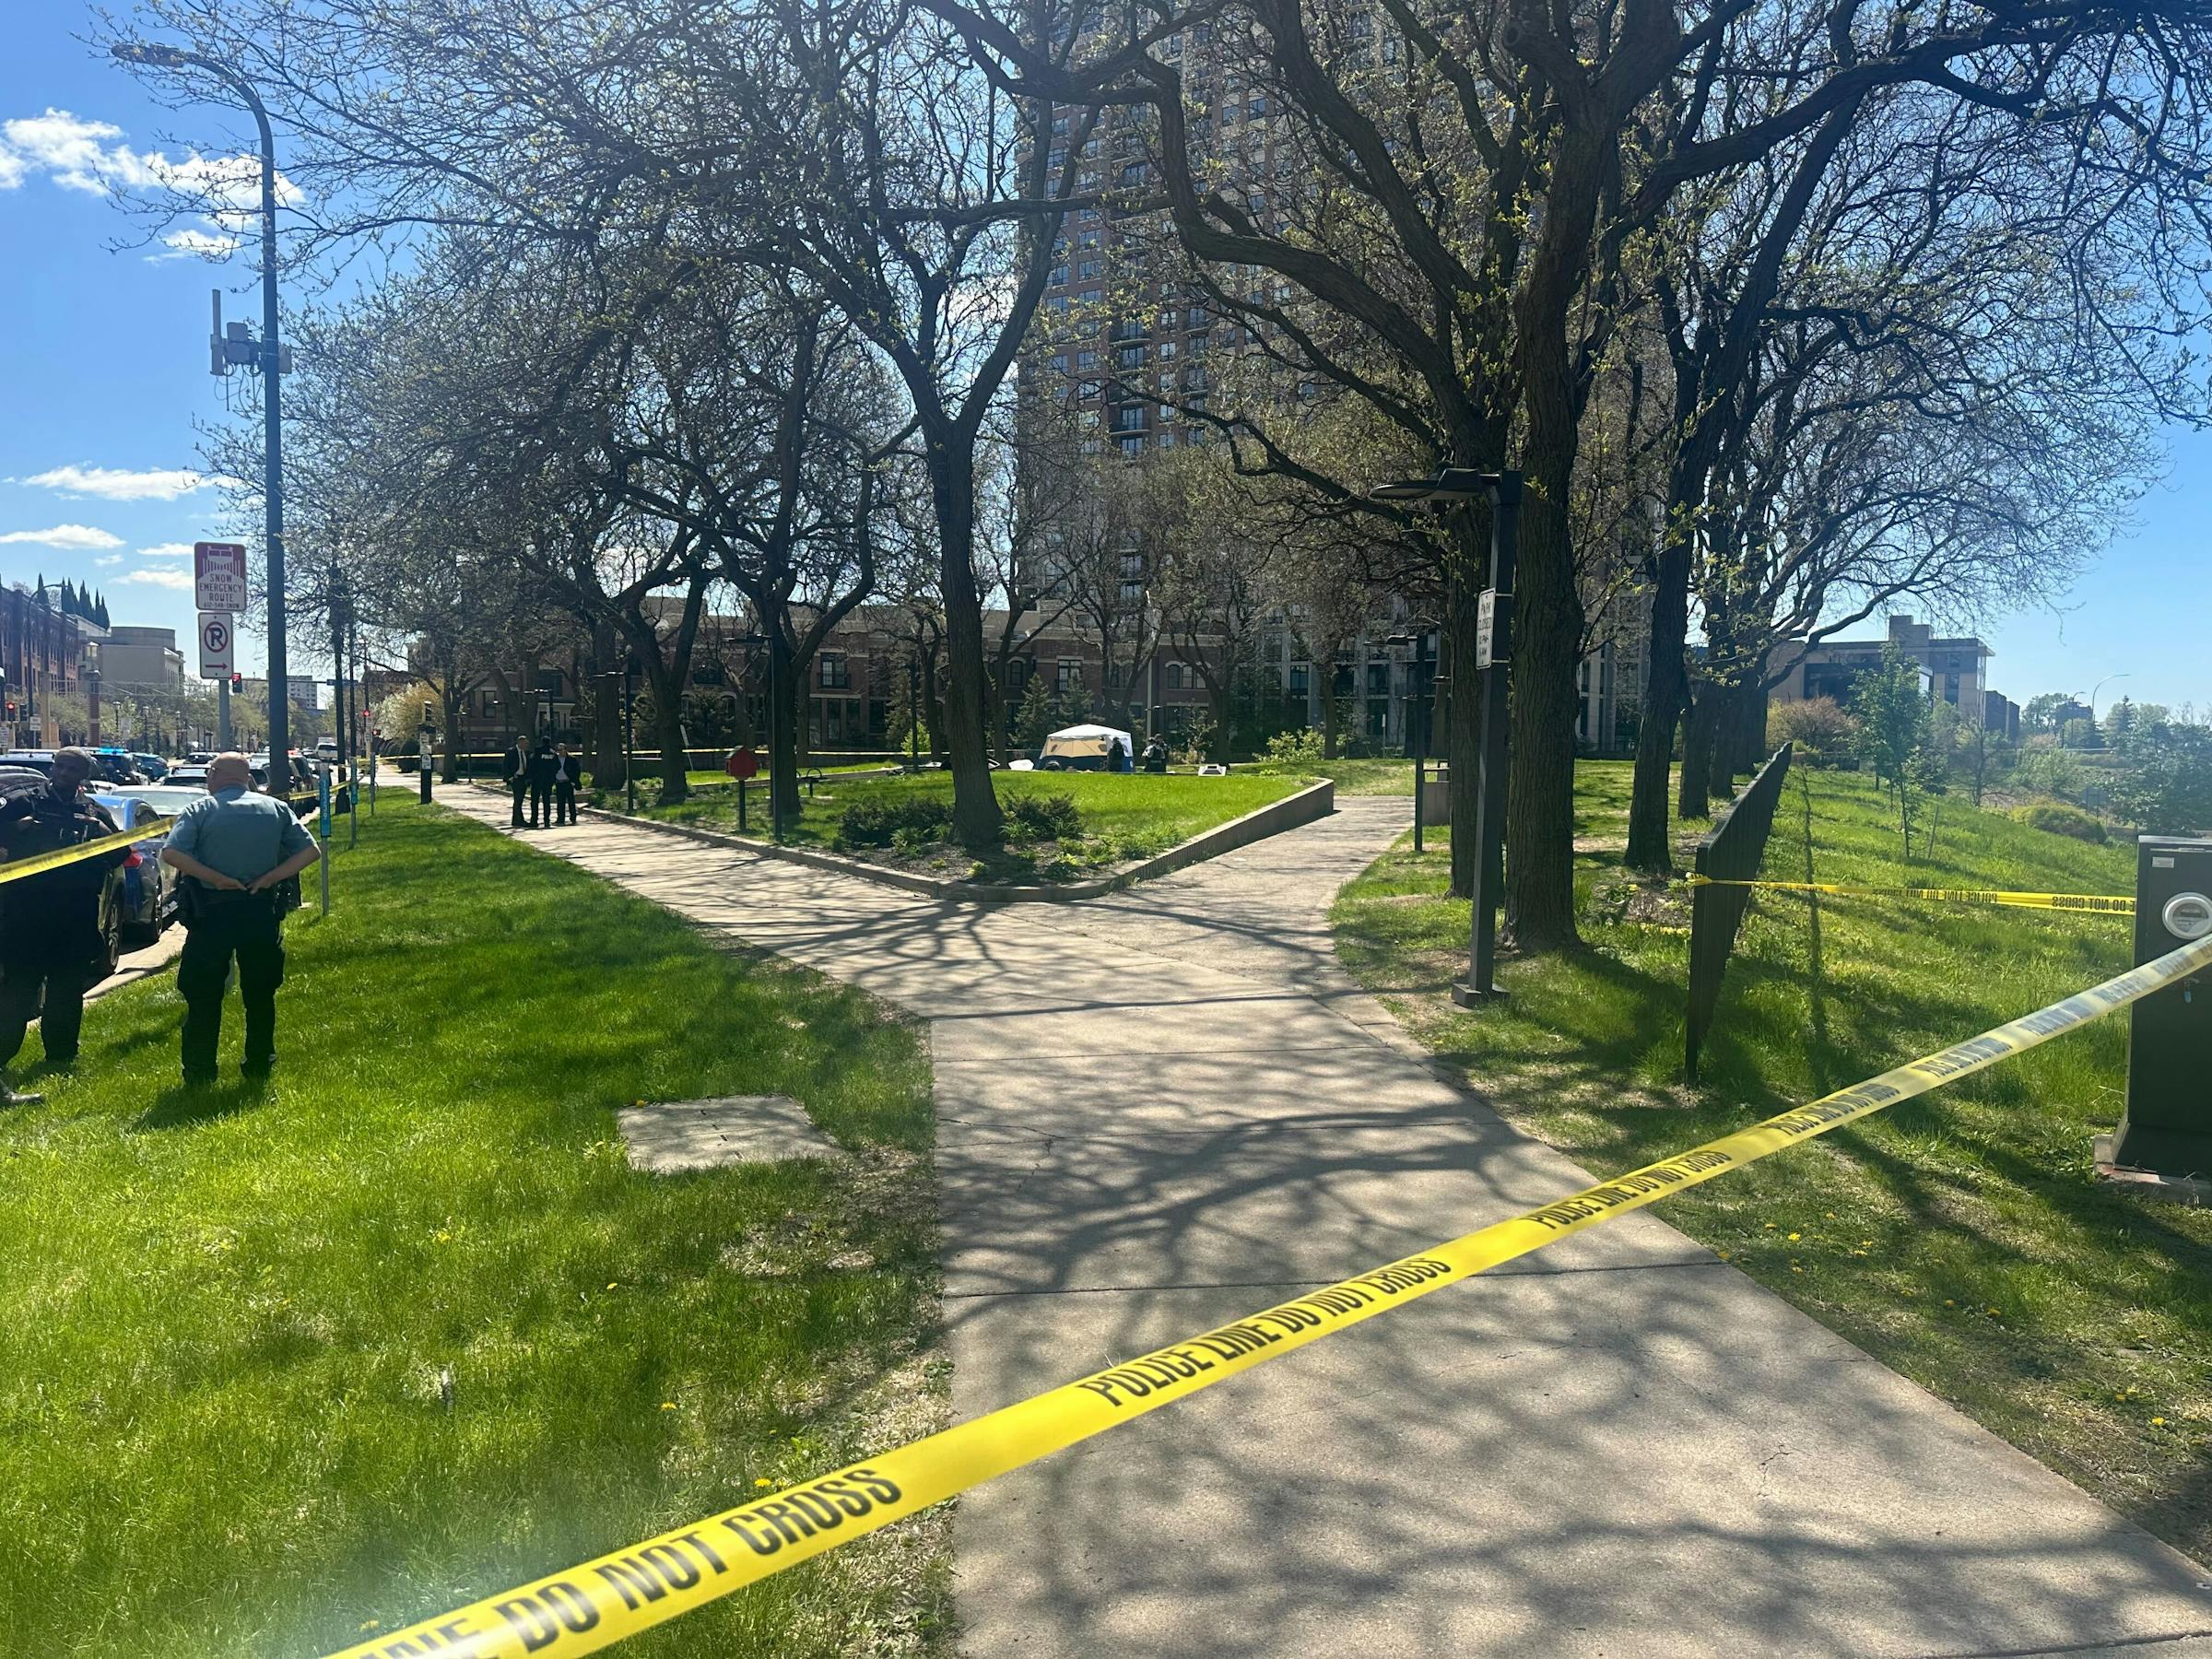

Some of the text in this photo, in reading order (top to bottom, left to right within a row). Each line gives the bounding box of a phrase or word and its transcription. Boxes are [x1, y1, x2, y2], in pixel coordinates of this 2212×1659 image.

[209, 573, 232, 583] SNOW
[199, 583, 242, 593] EMERGENCY
[209, 593, 234, 602] ROUTE
[1078, 1256, 1452, 1406] POLICE LINE DO NOT CROSS
[493, 1582, 601, 1654] DO
[596, 1529, 731, 1612] NOT
[720, 1468, 902, 1556] CROSS
